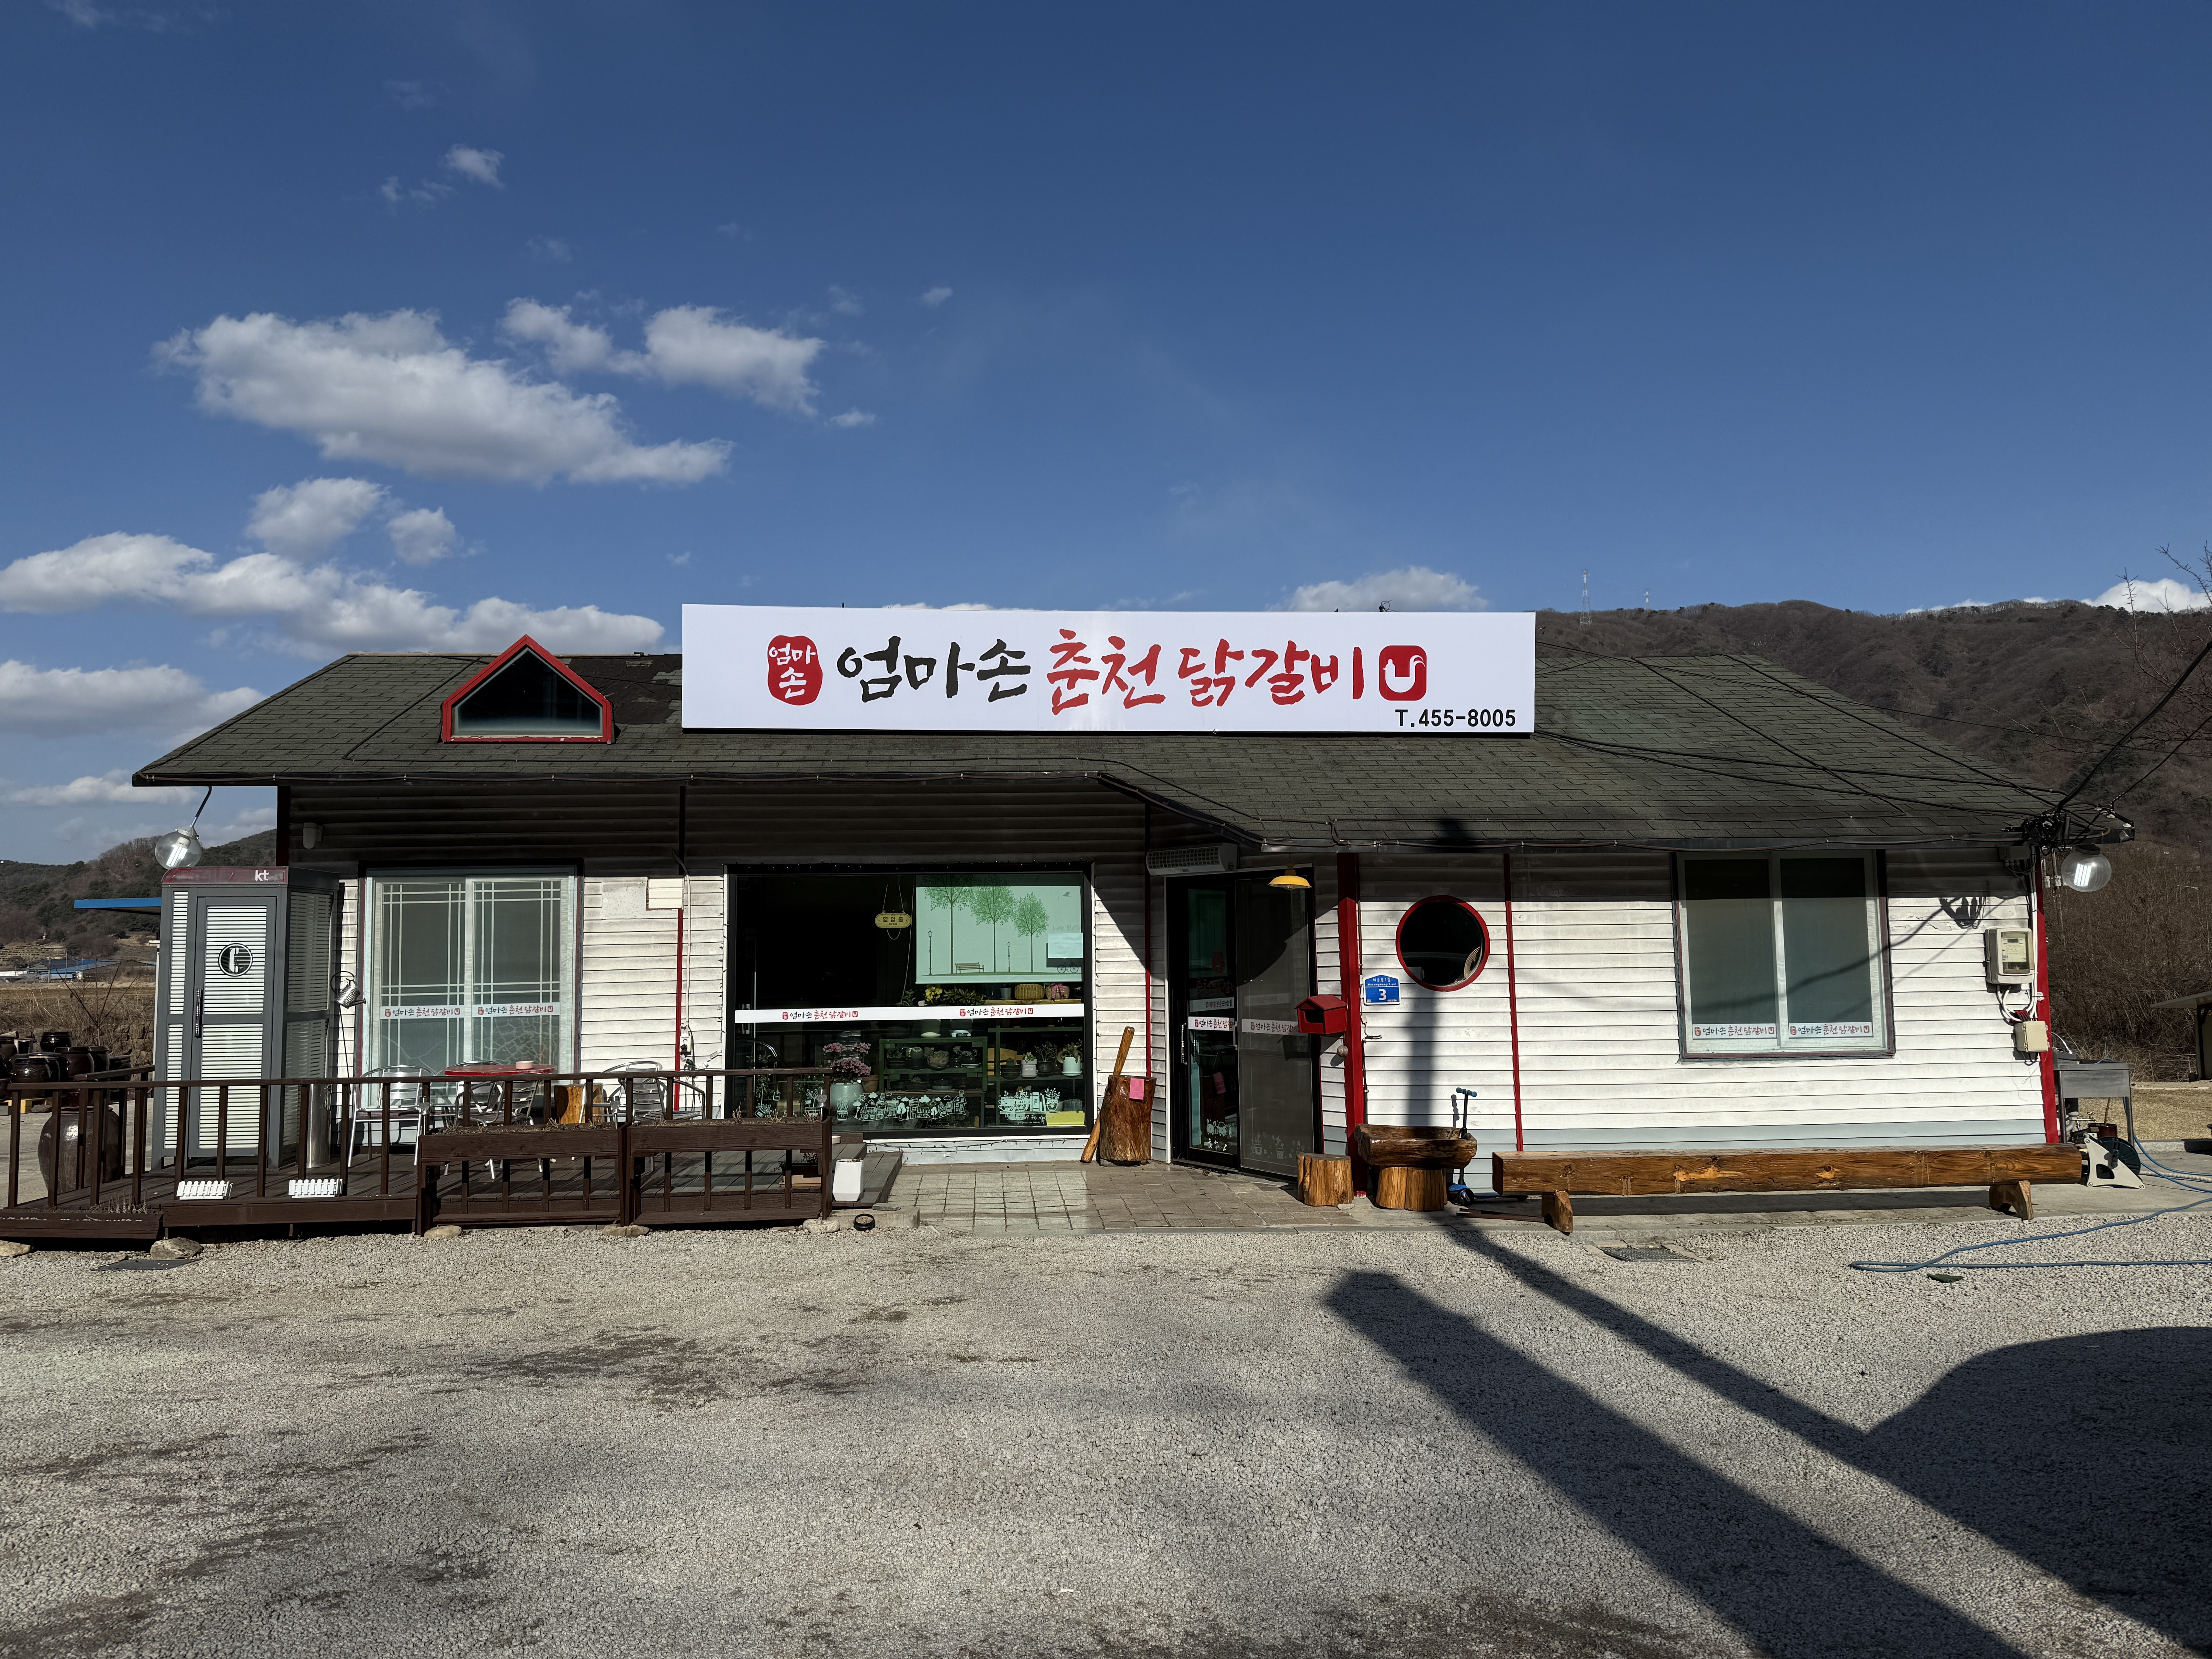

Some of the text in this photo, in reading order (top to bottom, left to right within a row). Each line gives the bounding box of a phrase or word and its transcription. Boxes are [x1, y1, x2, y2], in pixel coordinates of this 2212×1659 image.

[769, 642, 816, 665] 엄마
[837, 629, 1364, 716] 엄마손 춘천 닭갈비
[778, 666, 807, 699] 손
[1395, 709, 1516, 727] T.455-8005
[255, 870, 269, 881] kt
[1379, 989, 1386, 1000] 3
[392, 1008, 414, 1017] 엄마손
[416, 1007, 430, 1017] 춘천
[485, 1006, 507, 1015] 엄마손
[509, 1005, 523, 1015] 춘천
[814, 1010, 828, 1020] 춘천
[967, 1008, 989, 1016] 엄마손
[990, 1007, 1004, 1017] 춘천
[1271, 1022, 1281, 1032] 춘천
[1703, 1026, 1726, 1036] 엄마손
[1728, 1025, 1743, 1036] 춘천
[1798, 1025, 1822, 1034] 엄마손
[1823, 1024, 1838, 1036] 춘천
